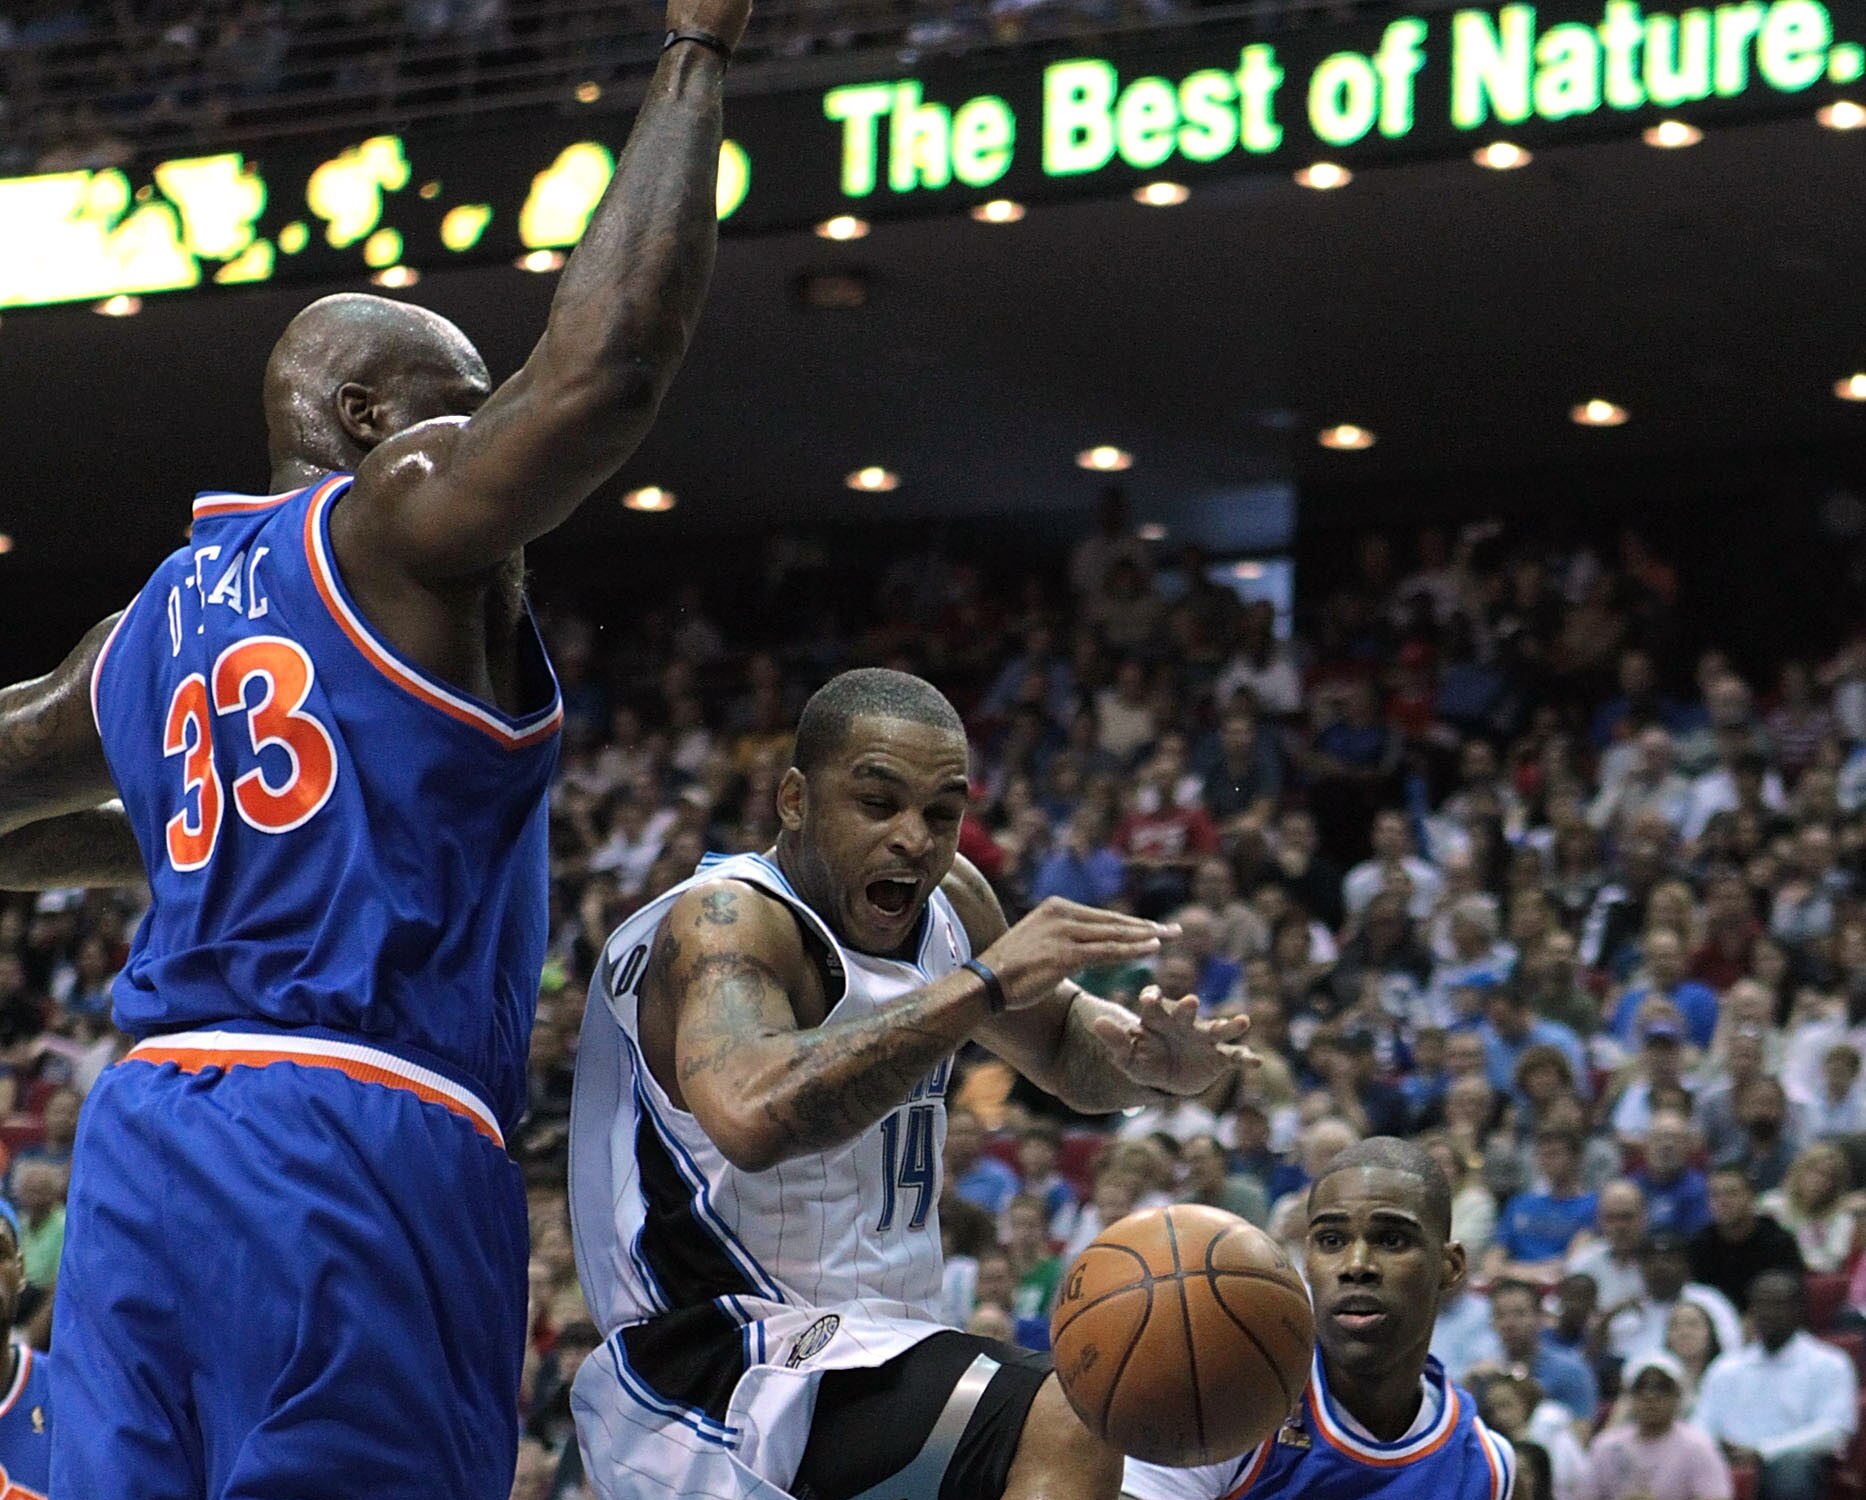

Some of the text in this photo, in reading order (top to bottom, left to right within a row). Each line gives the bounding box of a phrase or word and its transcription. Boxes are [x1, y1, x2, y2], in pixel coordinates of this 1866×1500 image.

[824, 0, 1865, 197] The Best of Nature.
[163, 634, 338, 872] 33
[876, 1104, 936, 1232] 14
